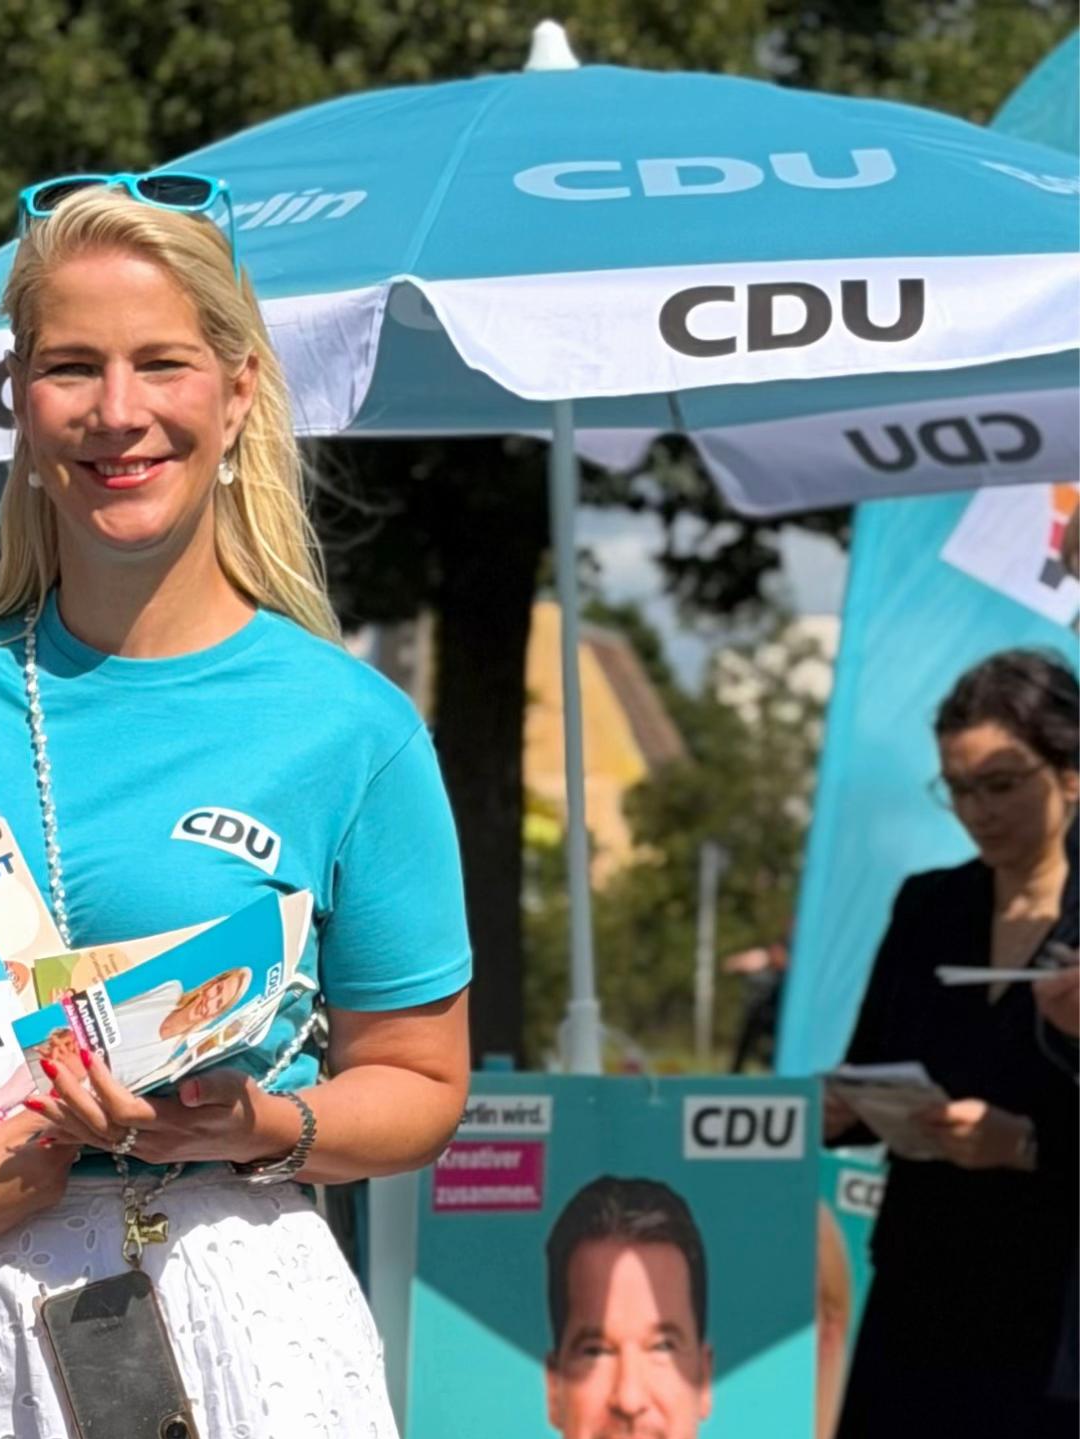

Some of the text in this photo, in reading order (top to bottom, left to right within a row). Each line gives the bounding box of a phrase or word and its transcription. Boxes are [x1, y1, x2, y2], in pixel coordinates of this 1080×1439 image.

[513, 148, 897, 200] CDU
[210, 187, 368, 231] rlin
[659, 278, 924, 358] CDU
[182, 812, 275, 860] CDU
[93, 990, 116, 1044] Manuela
[691, 1106, 797, 1148] CDU
[845, 1179, 884, 1207] CD
